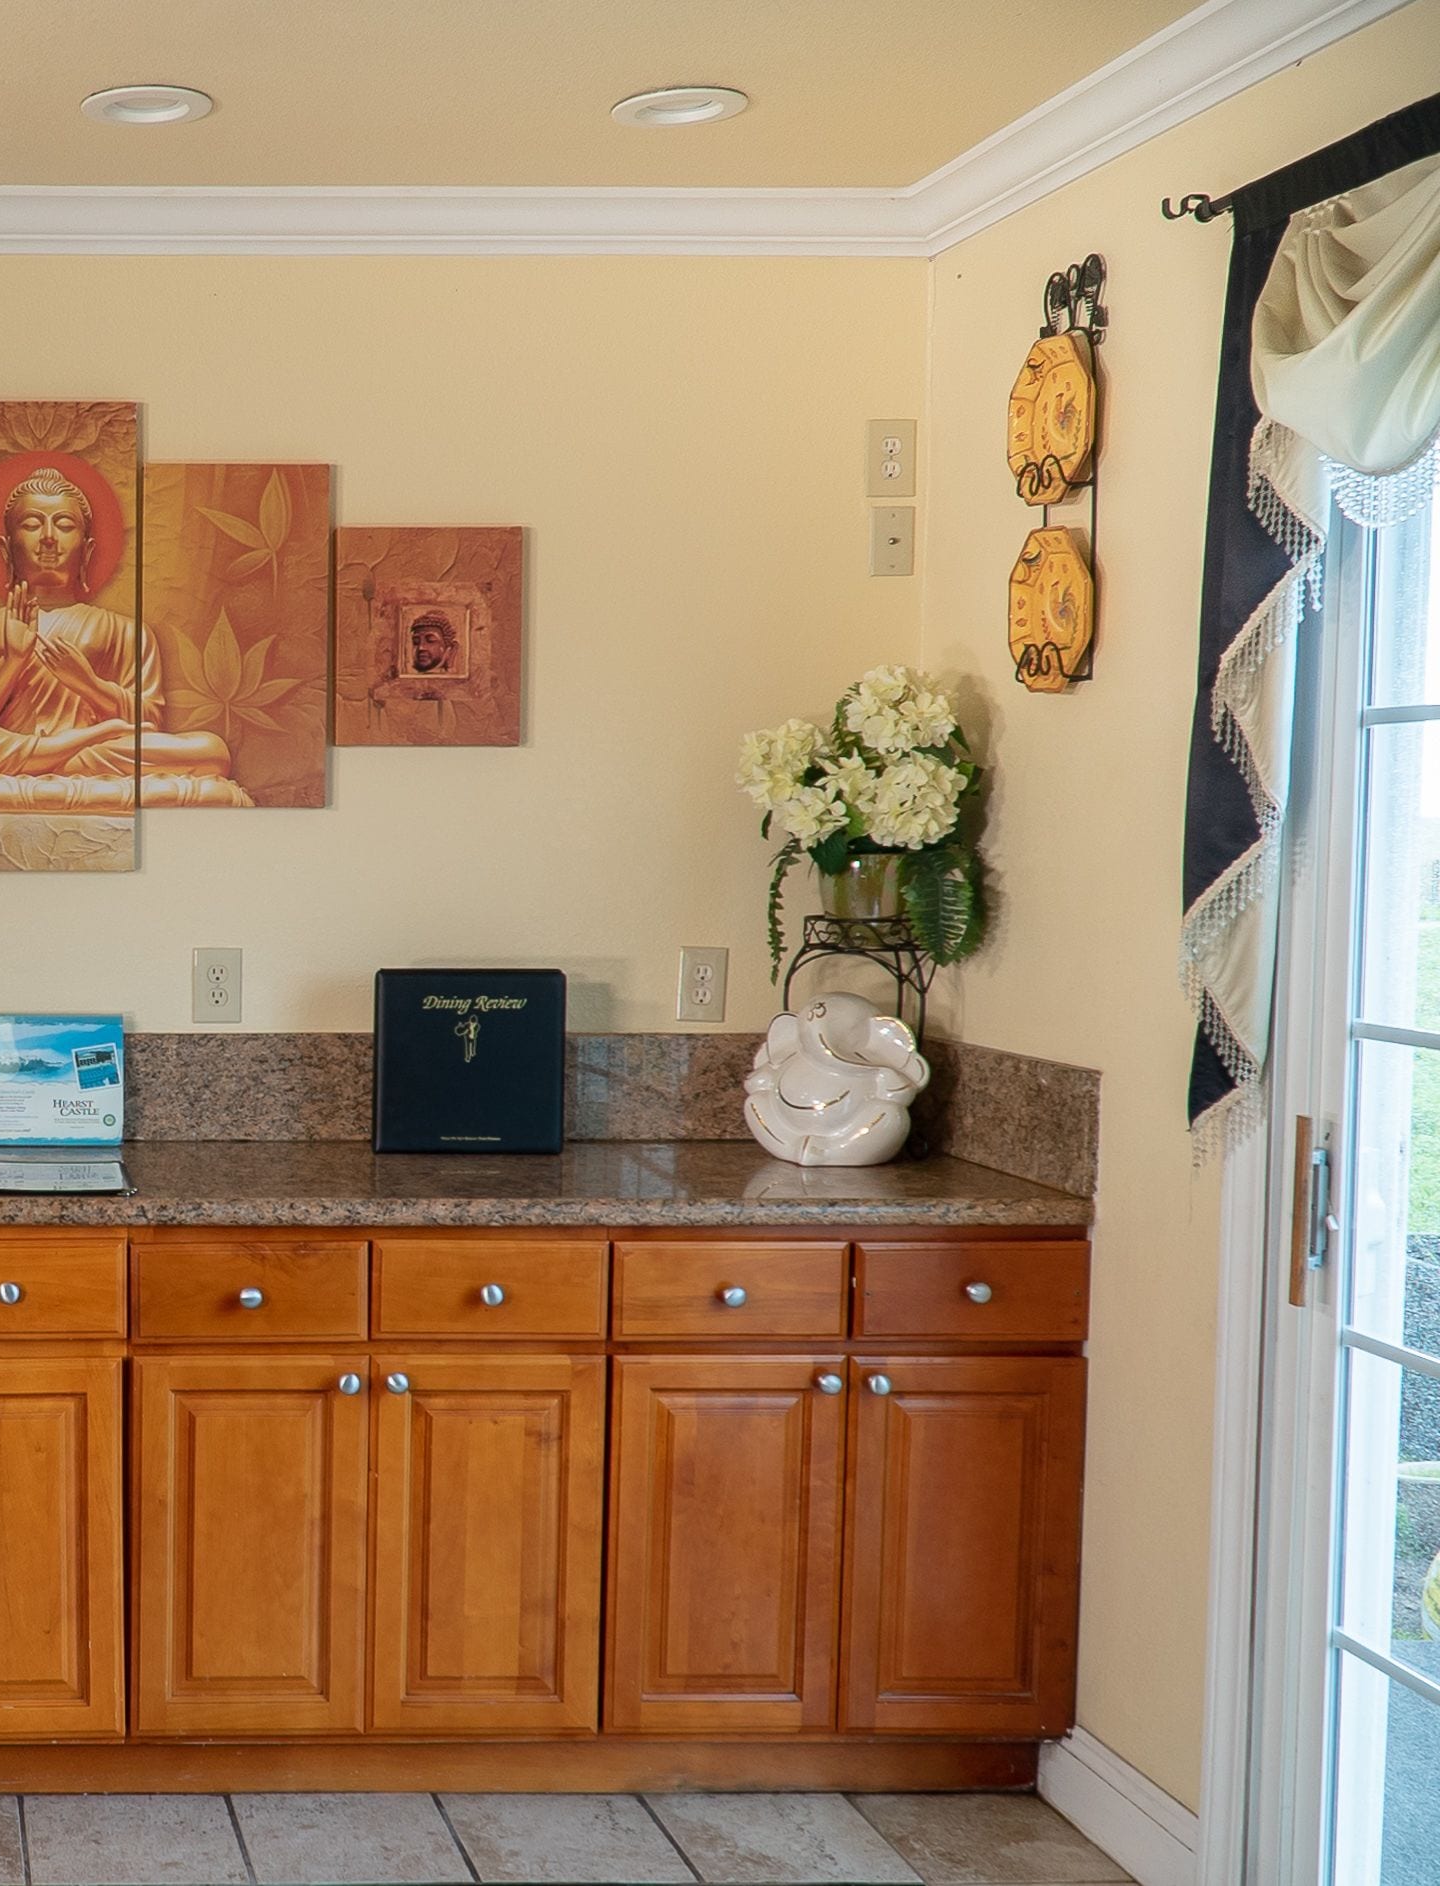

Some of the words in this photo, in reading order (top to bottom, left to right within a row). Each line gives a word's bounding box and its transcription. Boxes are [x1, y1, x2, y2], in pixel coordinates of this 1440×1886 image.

[422, 995, 472, 1015] Dining
[473, 995, 528, 1012] Review
[52, 1099, 94, 1109] HEARST
[60, 1108, 100, 1117] CASTLE
